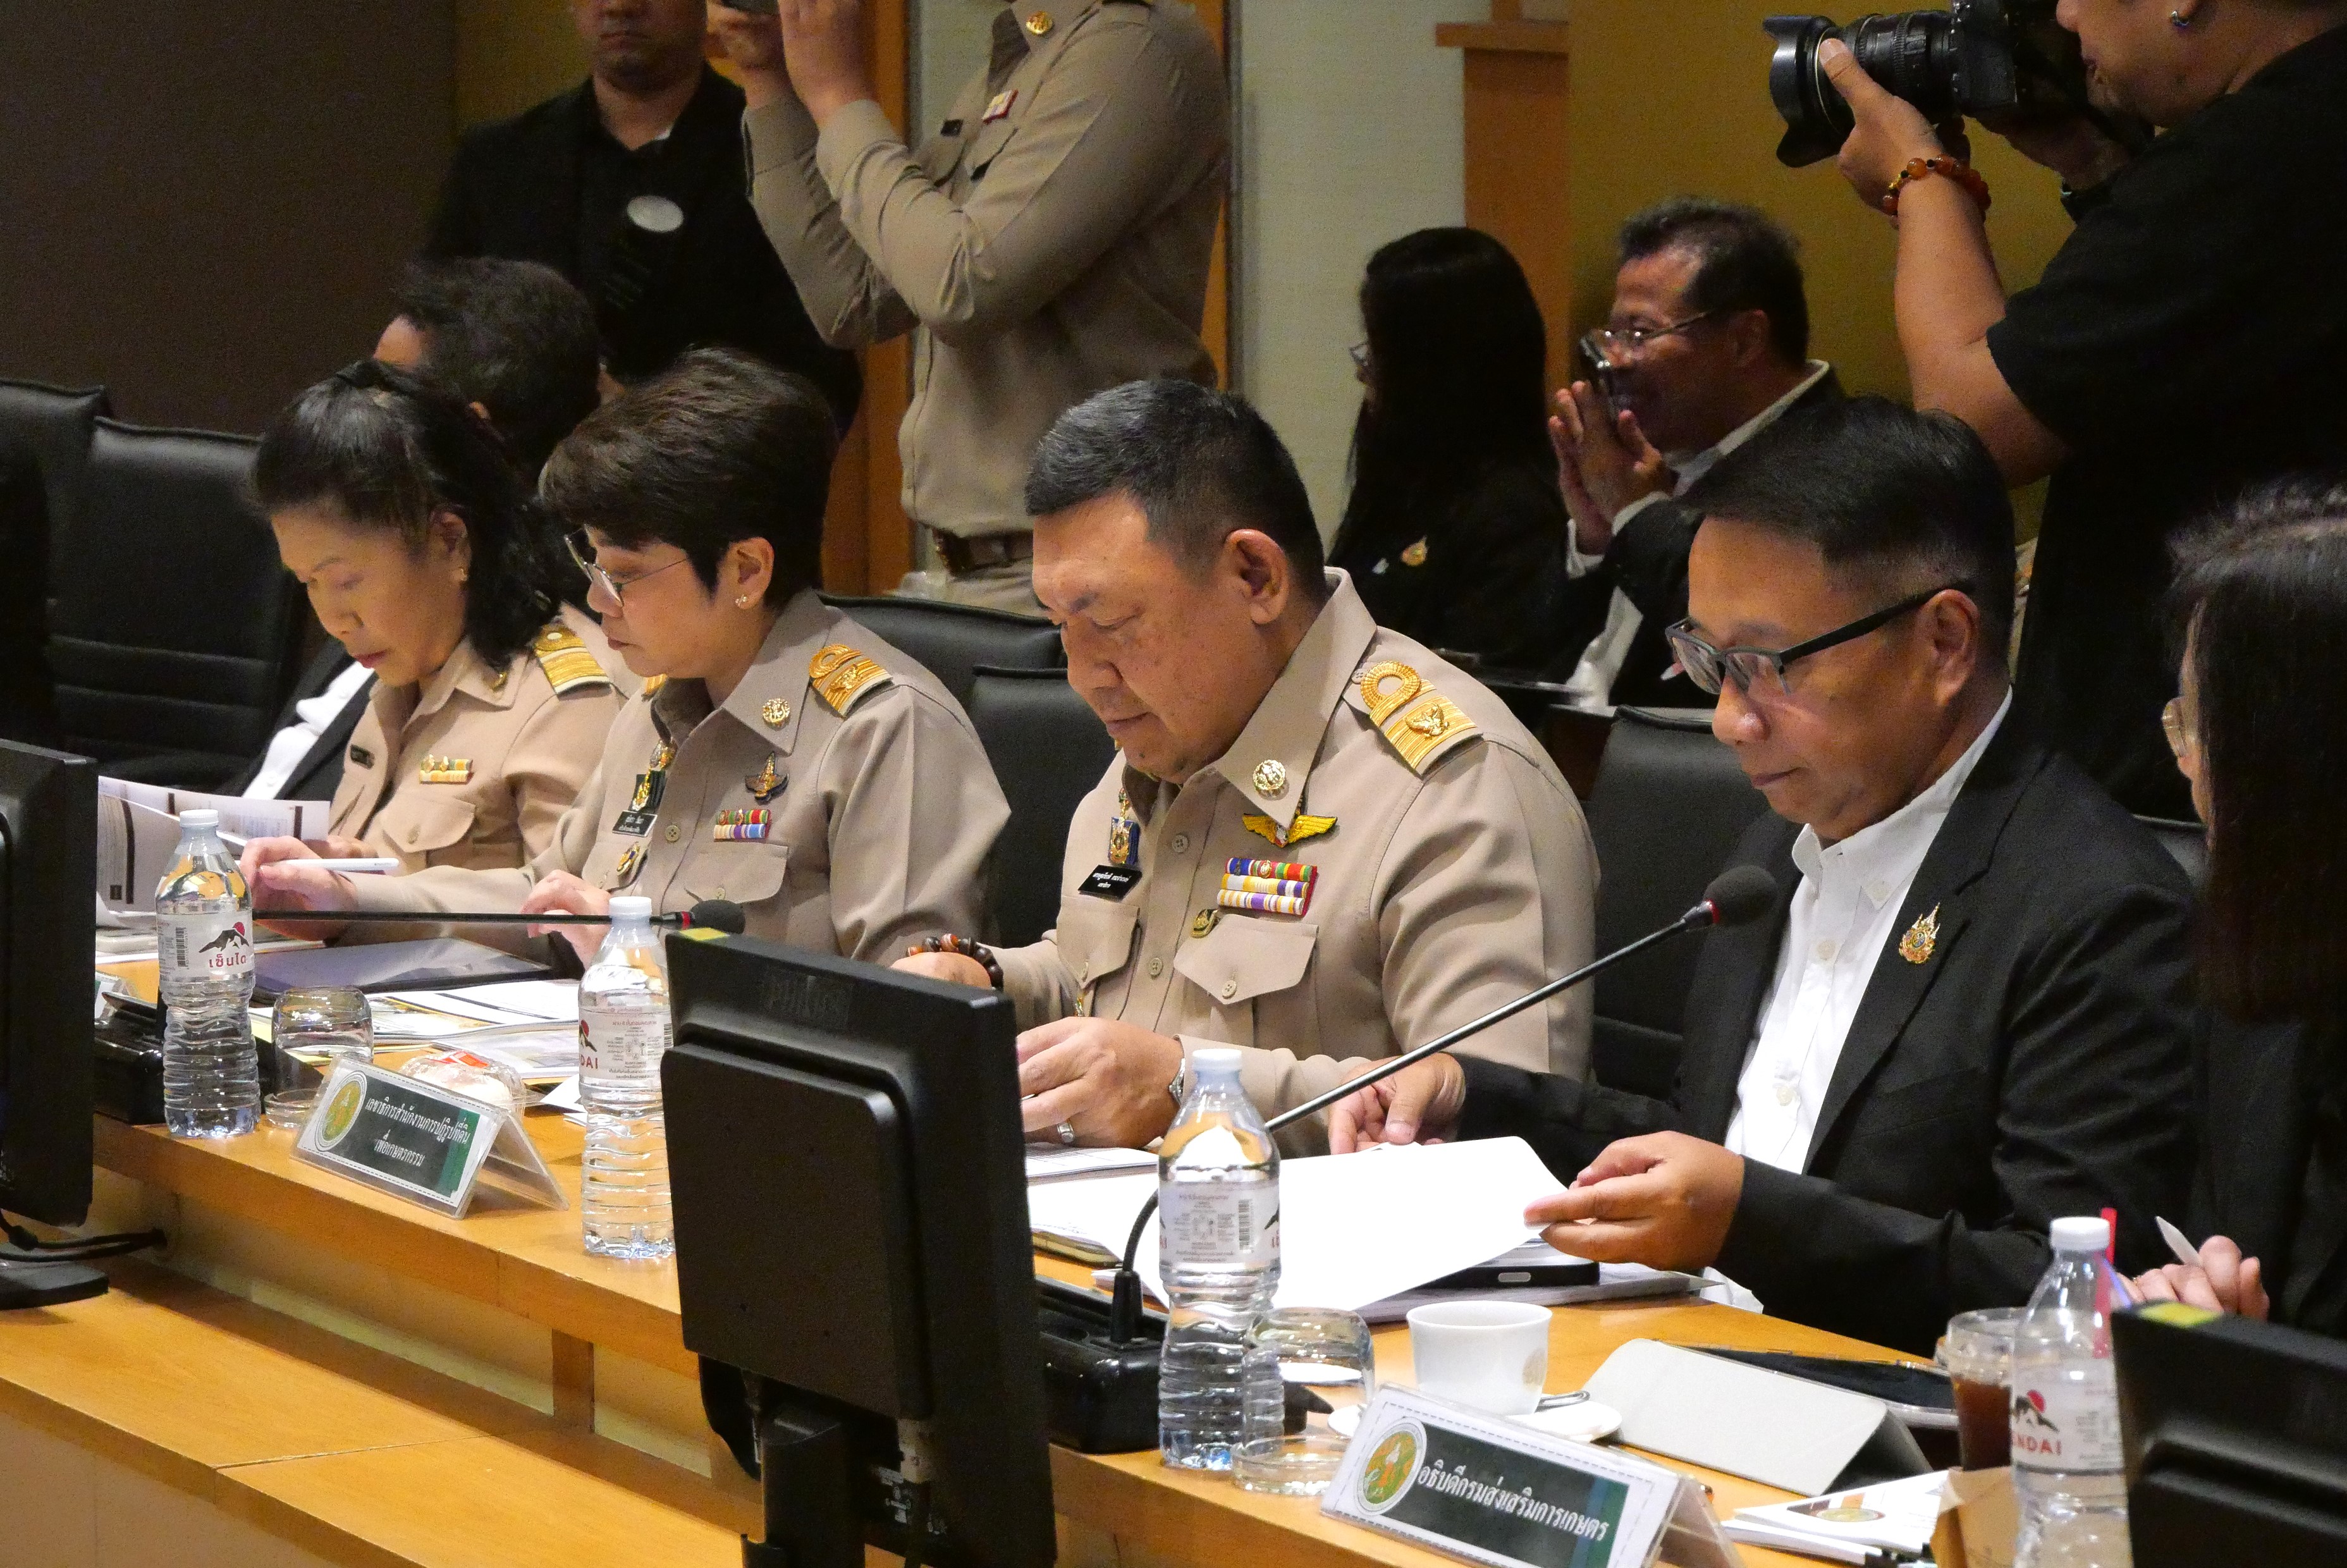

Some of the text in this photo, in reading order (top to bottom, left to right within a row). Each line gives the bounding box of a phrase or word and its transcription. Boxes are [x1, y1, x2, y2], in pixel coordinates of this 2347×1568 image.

[209, 952, 247, 968] เซ็นได
[580, 1053, 599, 1070] DAI
[365, 1096, 471, 1144] เลขาธิการสำนักงานการปฏิรูปที่ดิน
[374, 1129, 426, 1167] เพื่อเกษตรกรรม
[2013, 1430, 2062, 1456] NDAI
[1417, 1458, 1610, 1541] อธิบดีกรมส่งเสริมการเกษตร
